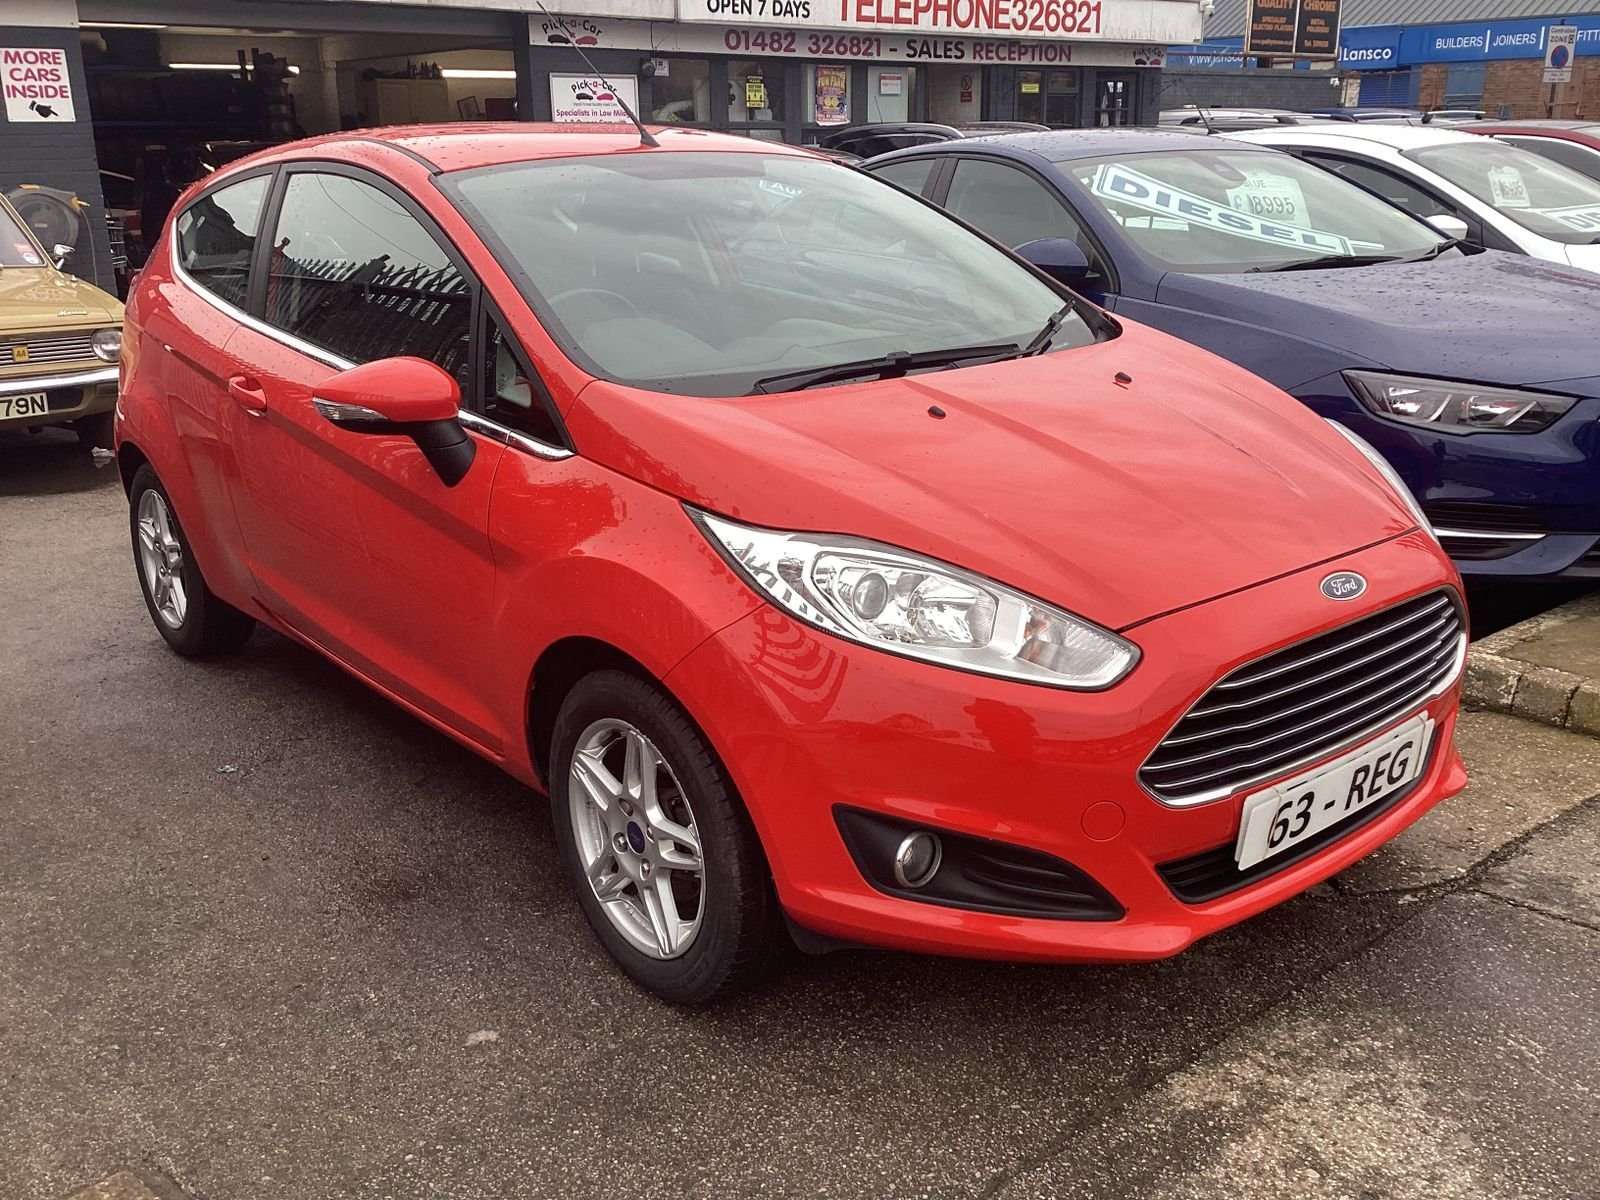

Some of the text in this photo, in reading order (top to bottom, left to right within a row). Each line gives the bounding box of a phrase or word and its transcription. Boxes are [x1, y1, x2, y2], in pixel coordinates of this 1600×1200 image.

[707, 0, 811, 18] OPEN 7 DAYS
[724, 29, 796, 52] 01482
[808, 34, 881, 57] 326821
[905, 39, 965, 60] SALES
[972, 41, 1072, 63] RECEPTION
[1435, 29, 1600, 49] BUILDERS JOINERS FITT
[3, 50, 62, 66] MORE
[9, 68, 63, 83] CARS
[5, 84, 70, 99] INSIDE
[592, 109, 598, 117] in
[600, 109, 612, 117] Low
[1110, 175, 1337, 250] DIESEL
[1331, 578, 1358, 597] Ford
[1268, 791, 1316, 849] 63
[1344, 740, 1414, 811] REG
